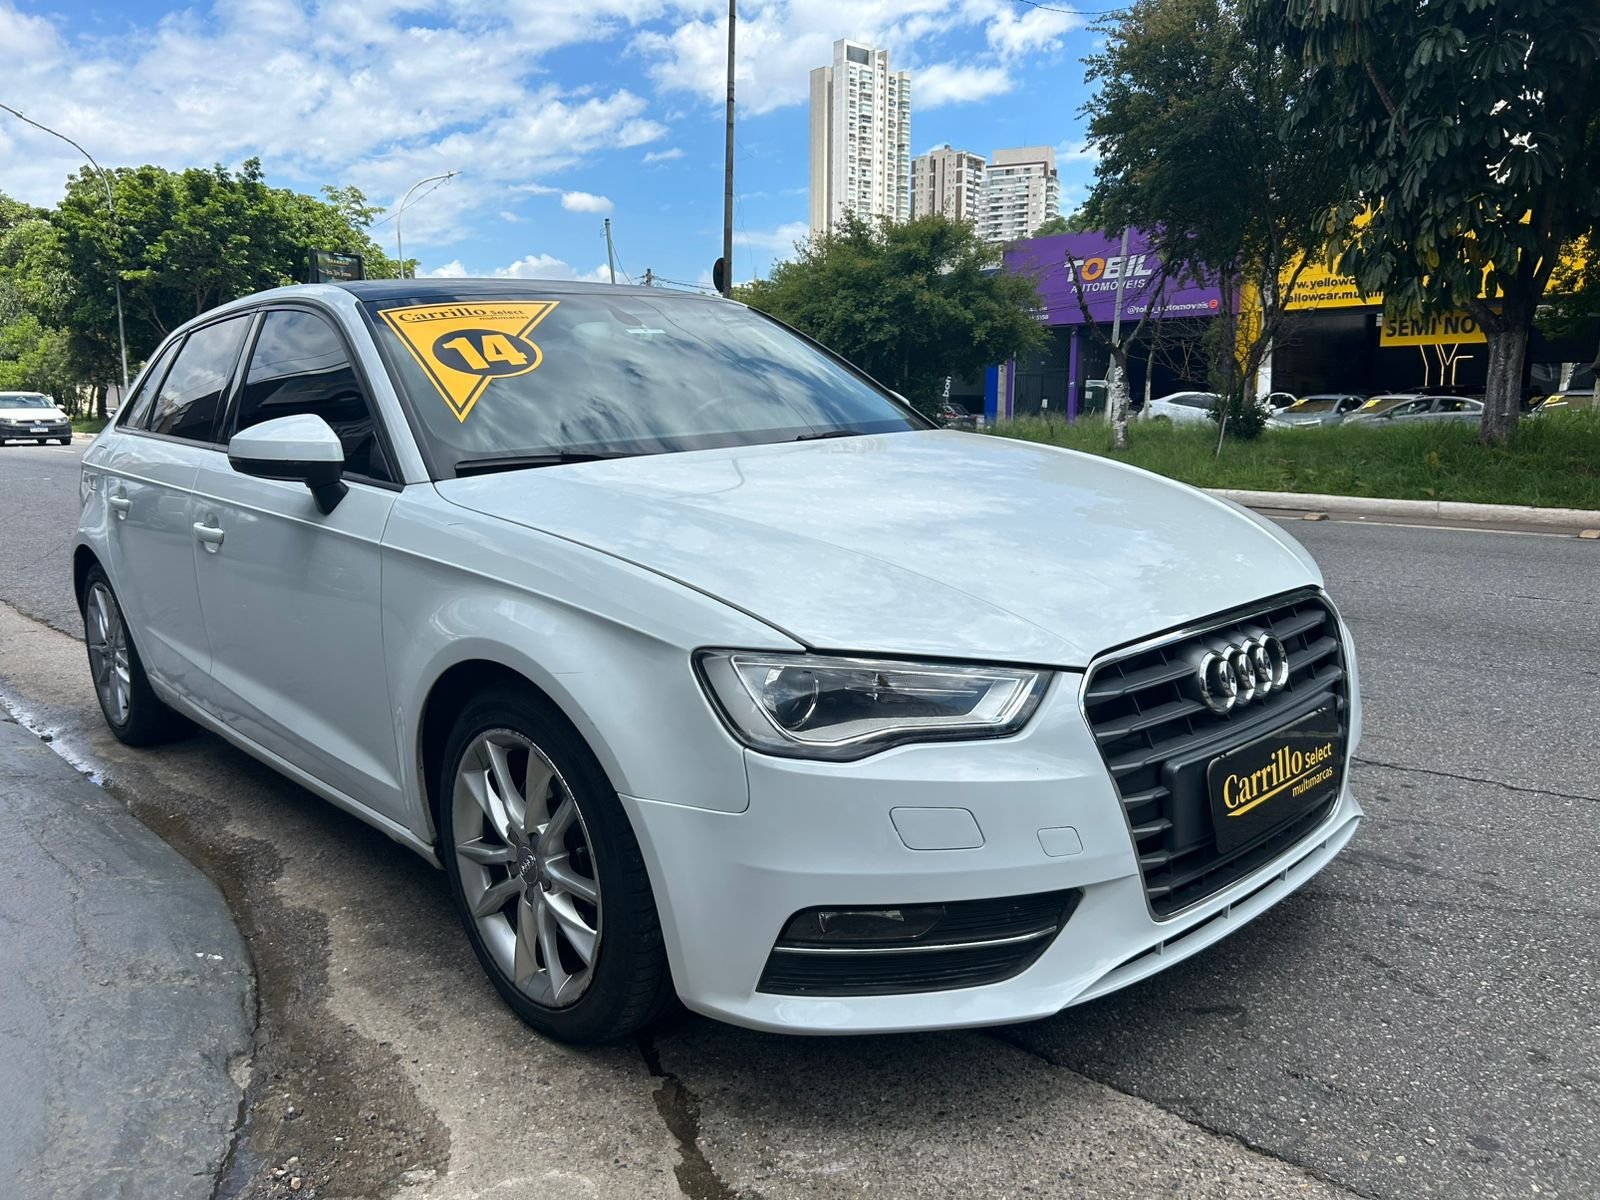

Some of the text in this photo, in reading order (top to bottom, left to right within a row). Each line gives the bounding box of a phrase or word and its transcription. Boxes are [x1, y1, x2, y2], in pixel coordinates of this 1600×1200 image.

[1064, 254, 1152, 282] TOBIL
[399, 307, 487, 321] Carrillo
[1385, 318, 1438, 337] SEMI
[442, 334, 528, 370] 14
[1223, 742, 1332, 809] Carrillo Select
[1292, 766, 1333, 797] multimarcas
